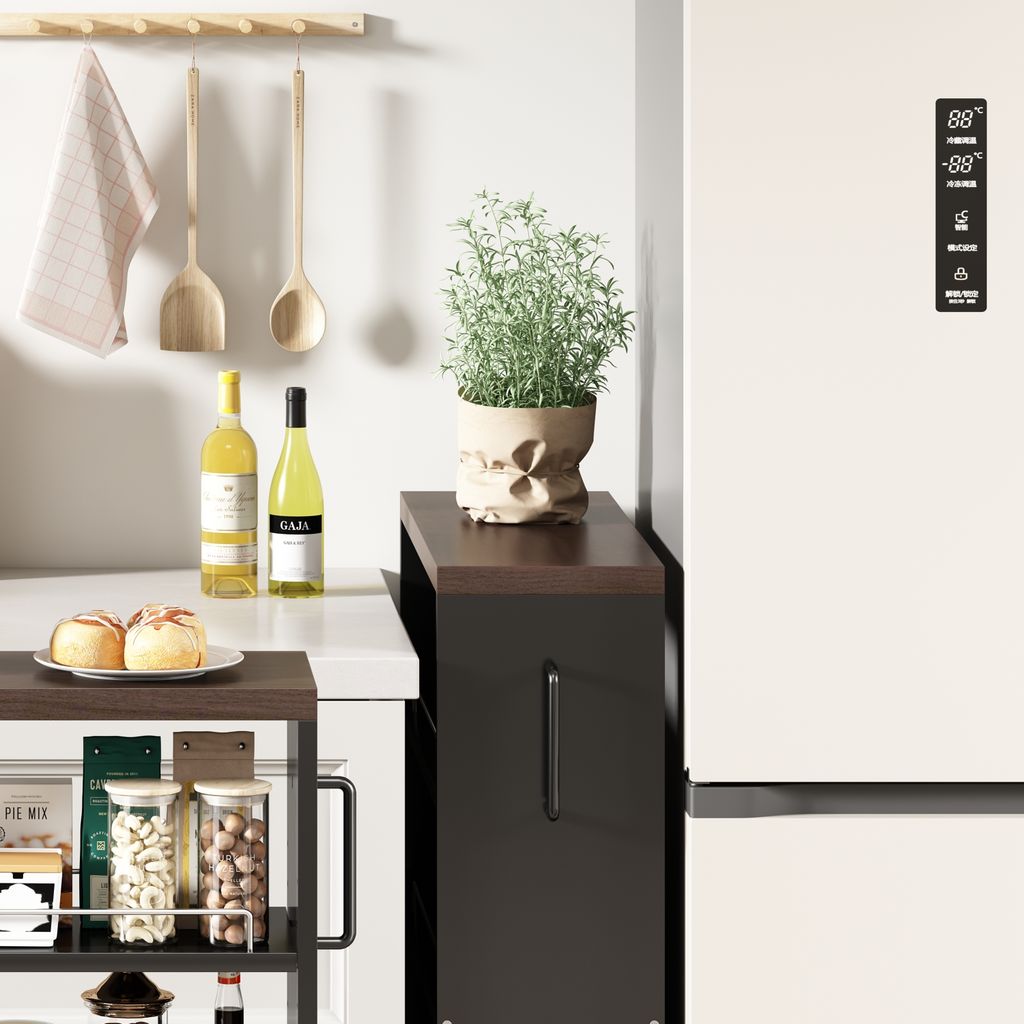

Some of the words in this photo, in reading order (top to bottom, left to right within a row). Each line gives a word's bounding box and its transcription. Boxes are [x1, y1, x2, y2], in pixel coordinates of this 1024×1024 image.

[280, 520, 309, 531] GAJA
[5, 806, 22, 820] PIE
[28, 806, 48, 820] MIX
